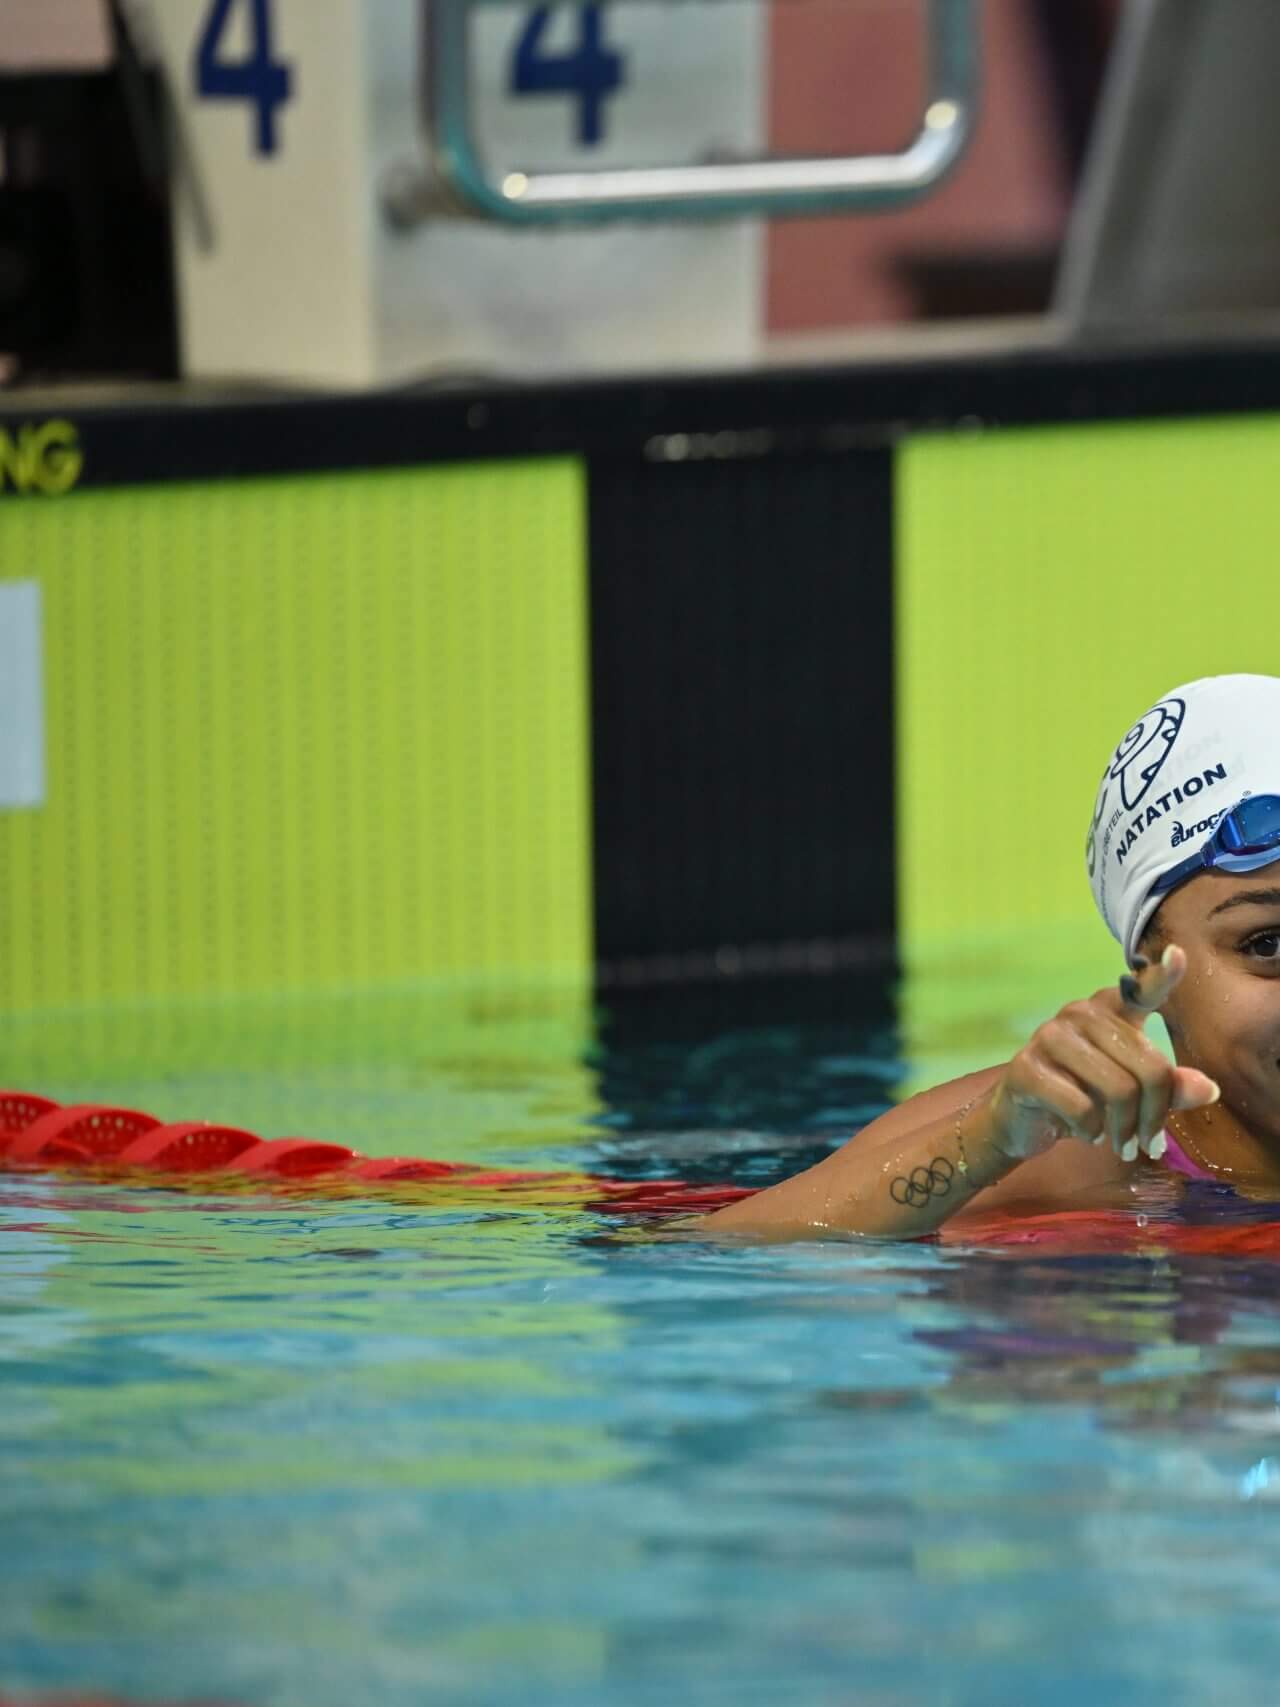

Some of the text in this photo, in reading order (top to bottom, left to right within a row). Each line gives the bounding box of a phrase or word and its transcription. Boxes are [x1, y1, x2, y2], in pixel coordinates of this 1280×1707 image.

[194, 0, 293, 158] 4
[510, 0, 627, 147] 4
[1115, 763, 1227, 866] NATATION
